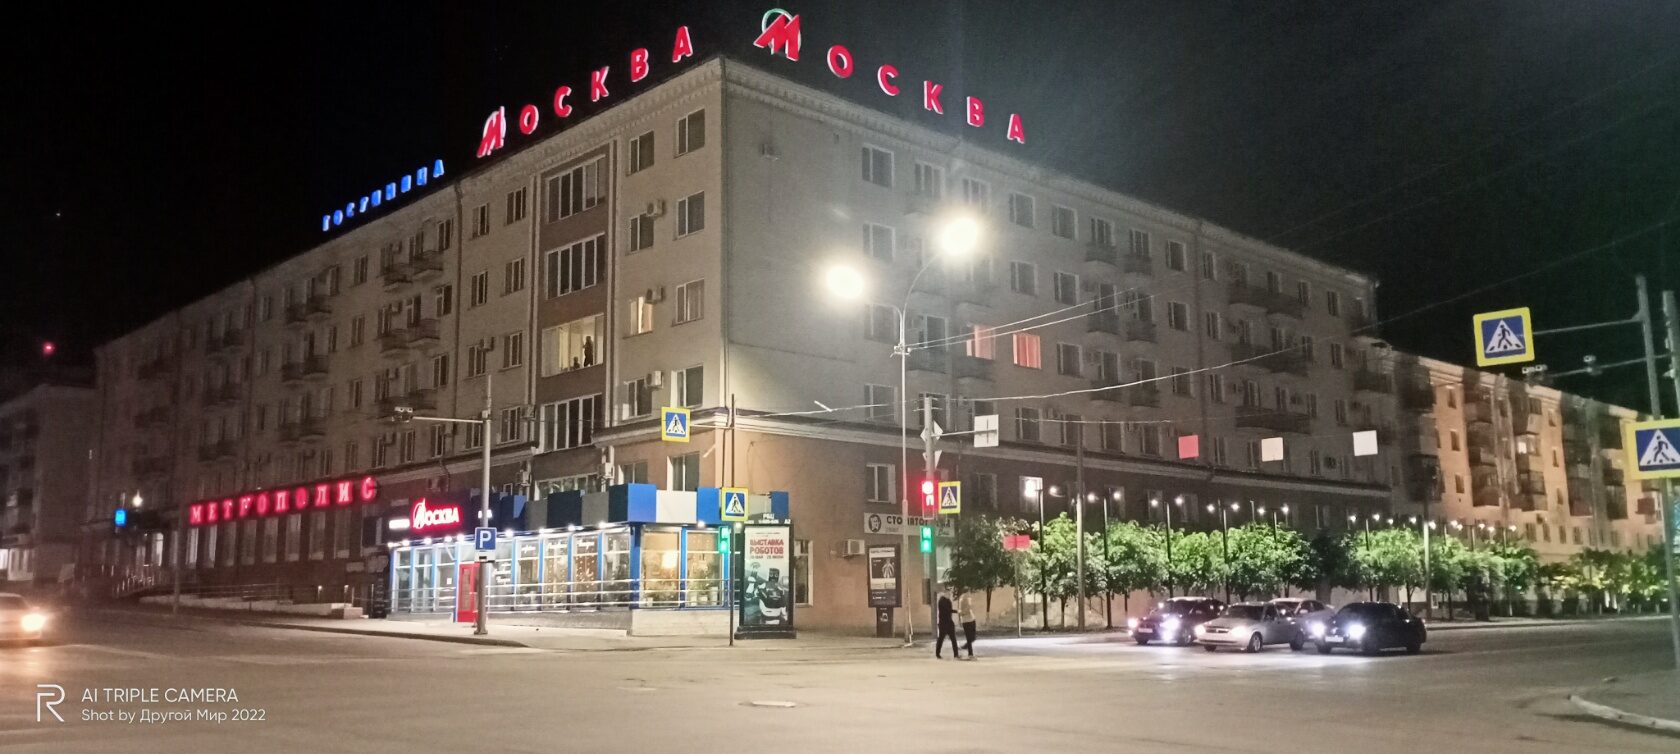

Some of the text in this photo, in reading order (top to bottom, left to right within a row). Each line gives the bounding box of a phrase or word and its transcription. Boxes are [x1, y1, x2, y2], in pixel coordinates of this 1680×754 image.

[477, 25, 693, 158] МОСКВА
[753, 8, 1025, 144] МОСКВА
[189, 475, 376, 525] МЕТРОПОЛИС
[479, 530, 492, 549] P
[749, 547, 784, 555] РОБОТОВ
